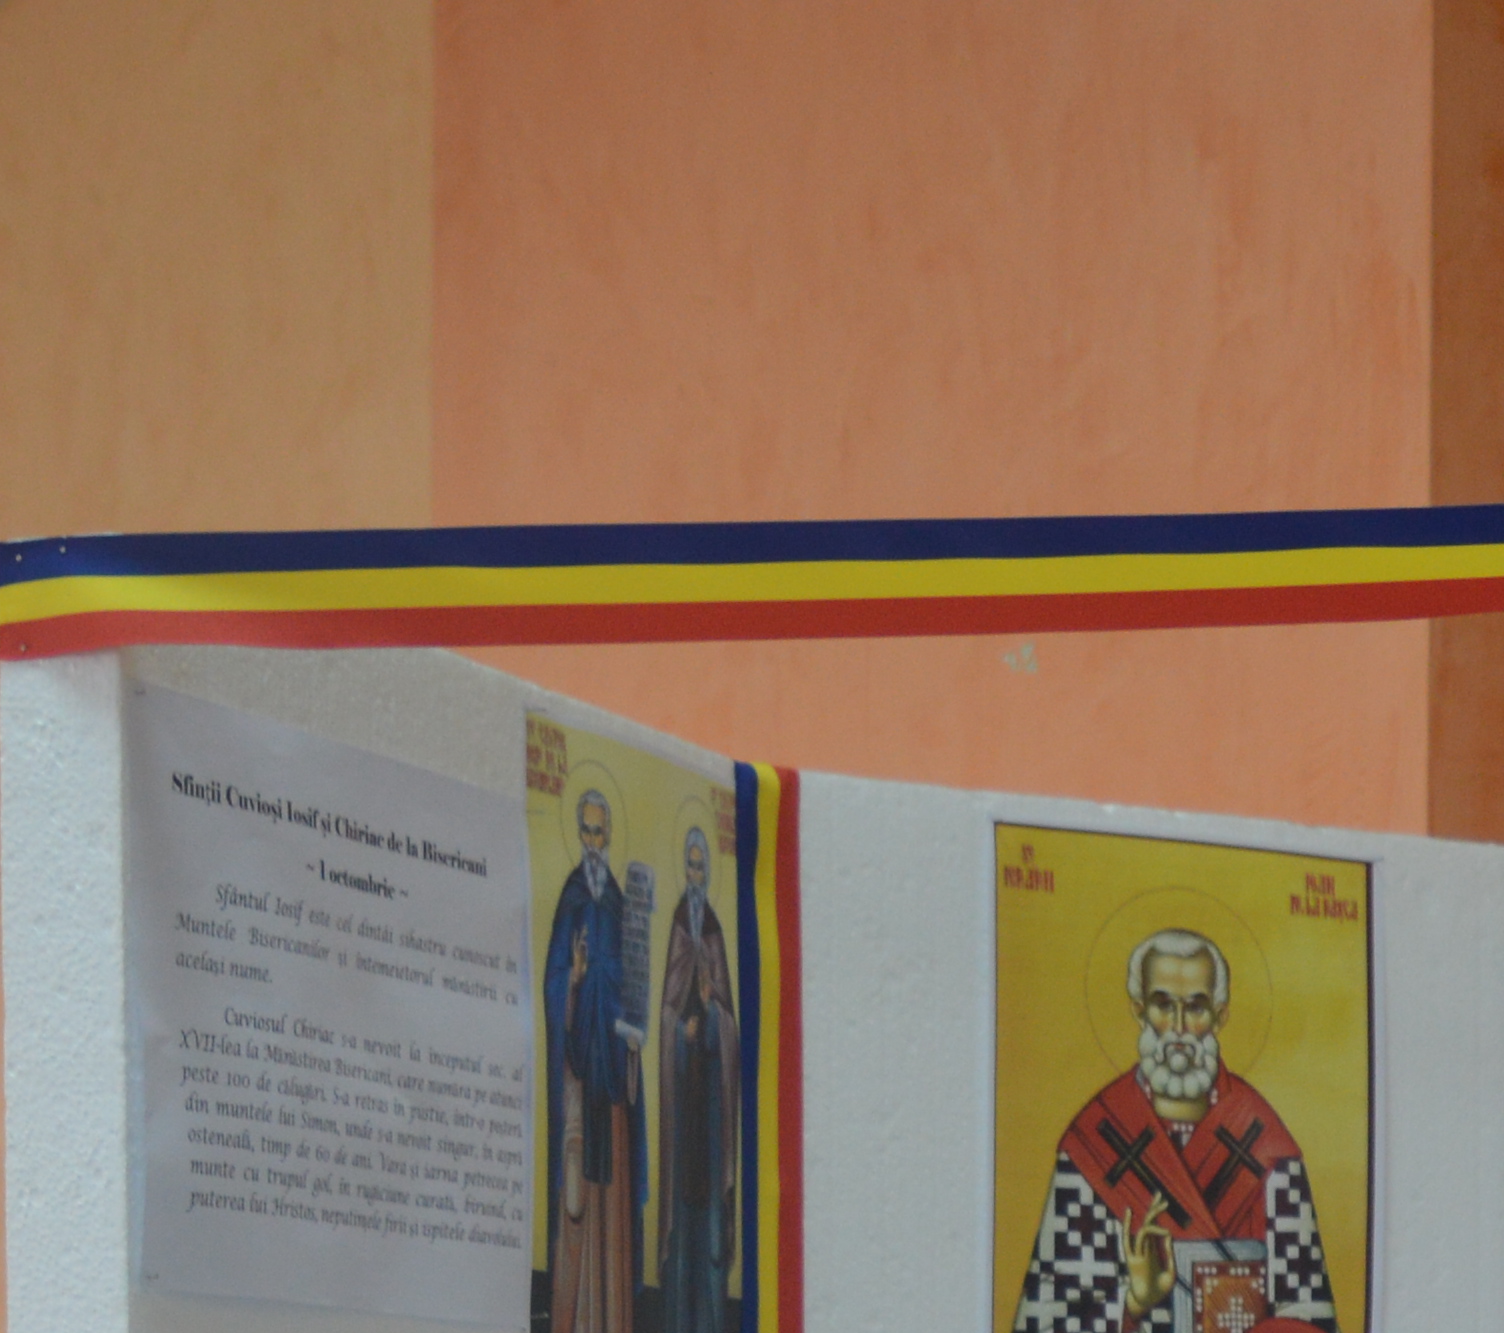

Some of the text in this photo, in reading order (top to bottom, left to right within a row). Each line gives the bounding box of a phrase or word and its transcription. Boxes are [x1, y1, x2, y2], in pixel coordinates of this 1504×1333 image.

[171, 773, 487, 877] Sfinții Cuvioși Iosif și Chiriac de la Bisericani
[319, 859, 395, 899] 1 octombrie
